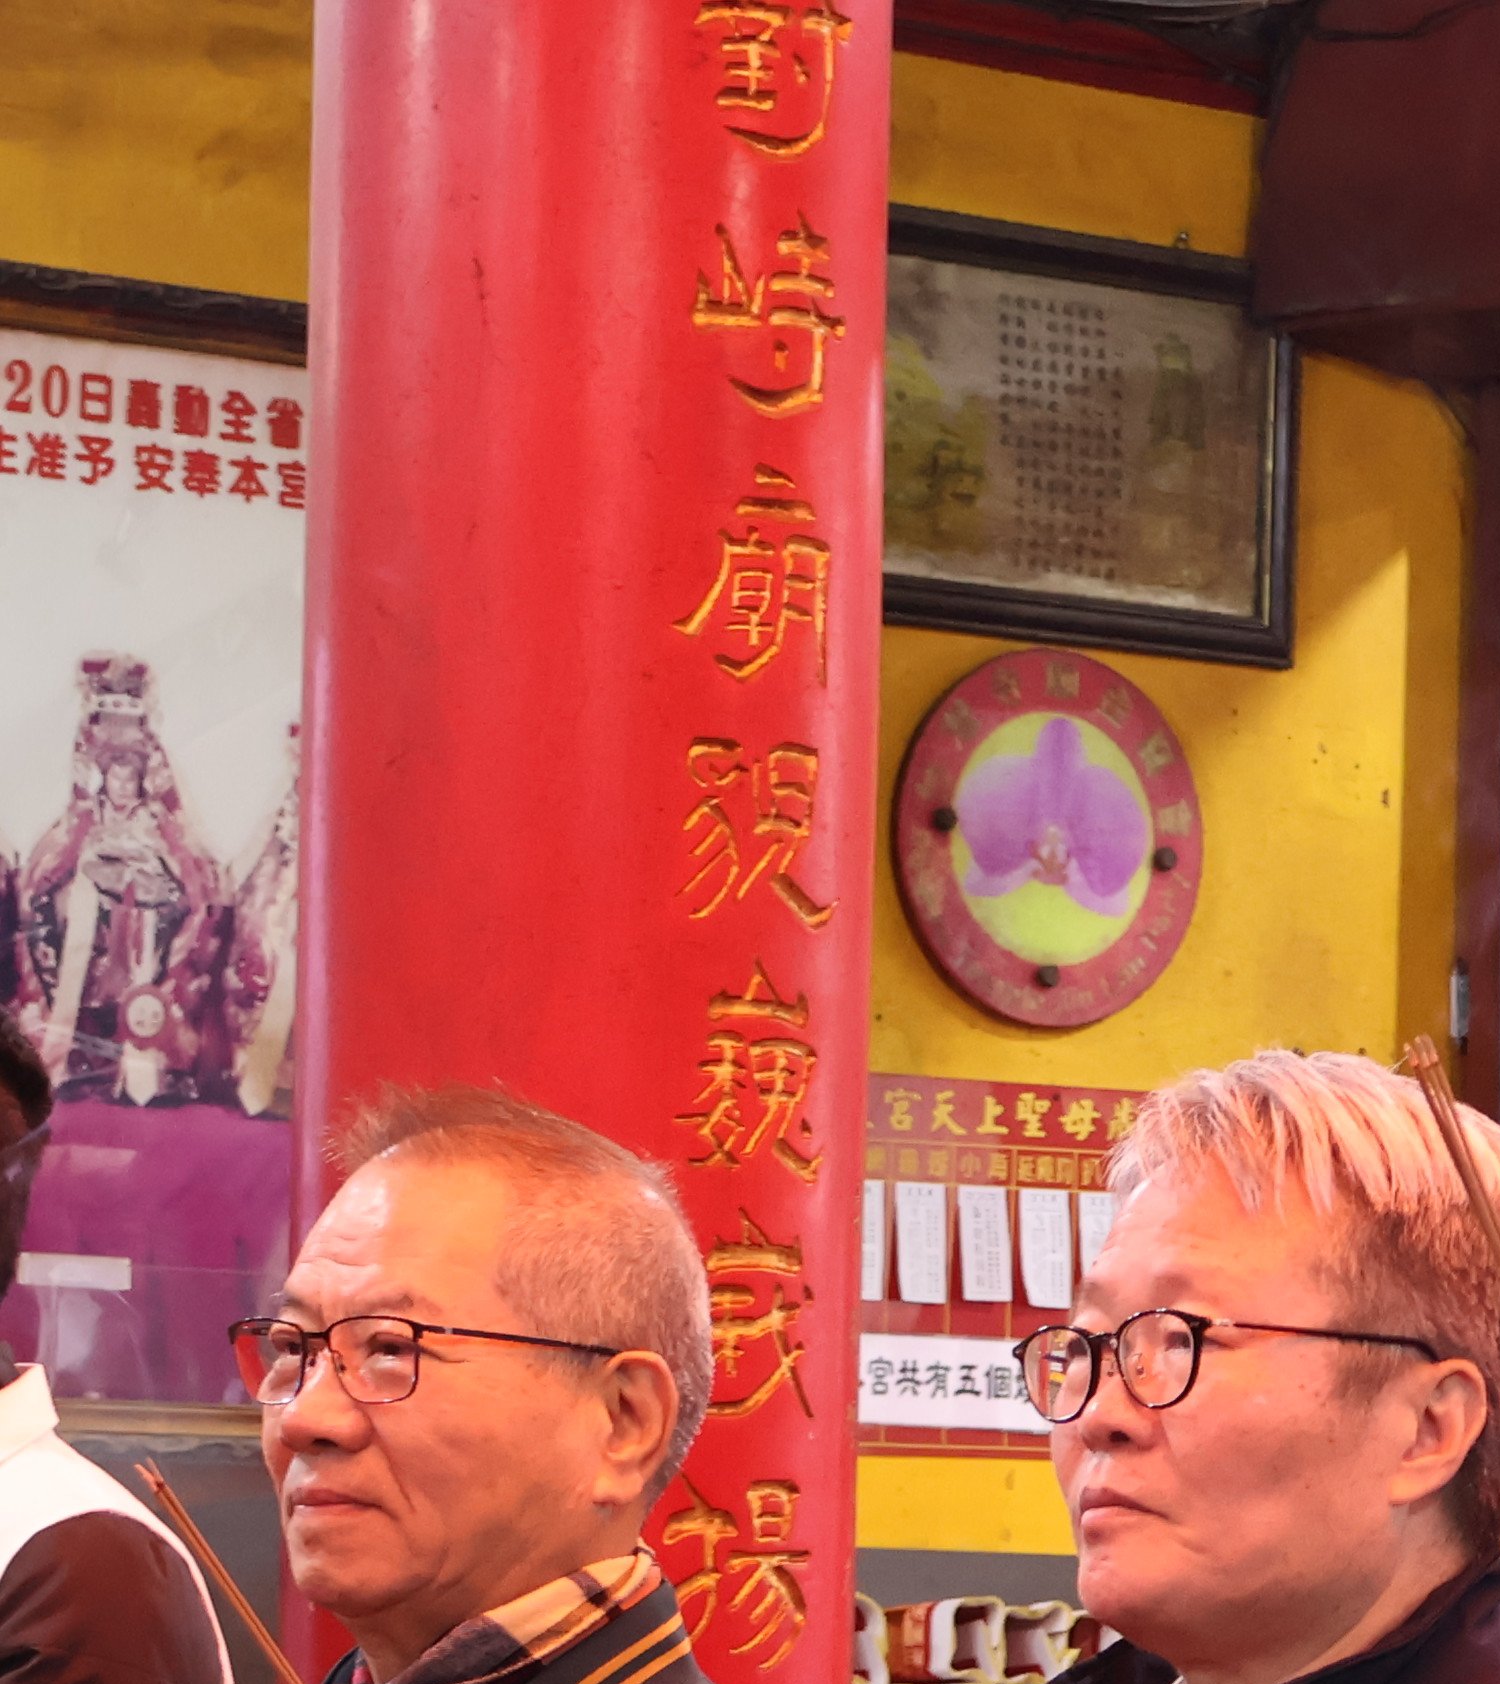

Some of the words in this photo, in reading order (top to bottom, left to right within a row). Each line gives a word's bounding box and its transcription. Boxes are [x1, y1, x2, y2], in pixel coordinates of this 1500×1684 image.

[863, 1088, 1140, 1142] 宮天上聖母
[859, 1356, 1030, 1403] 宮共有五個
